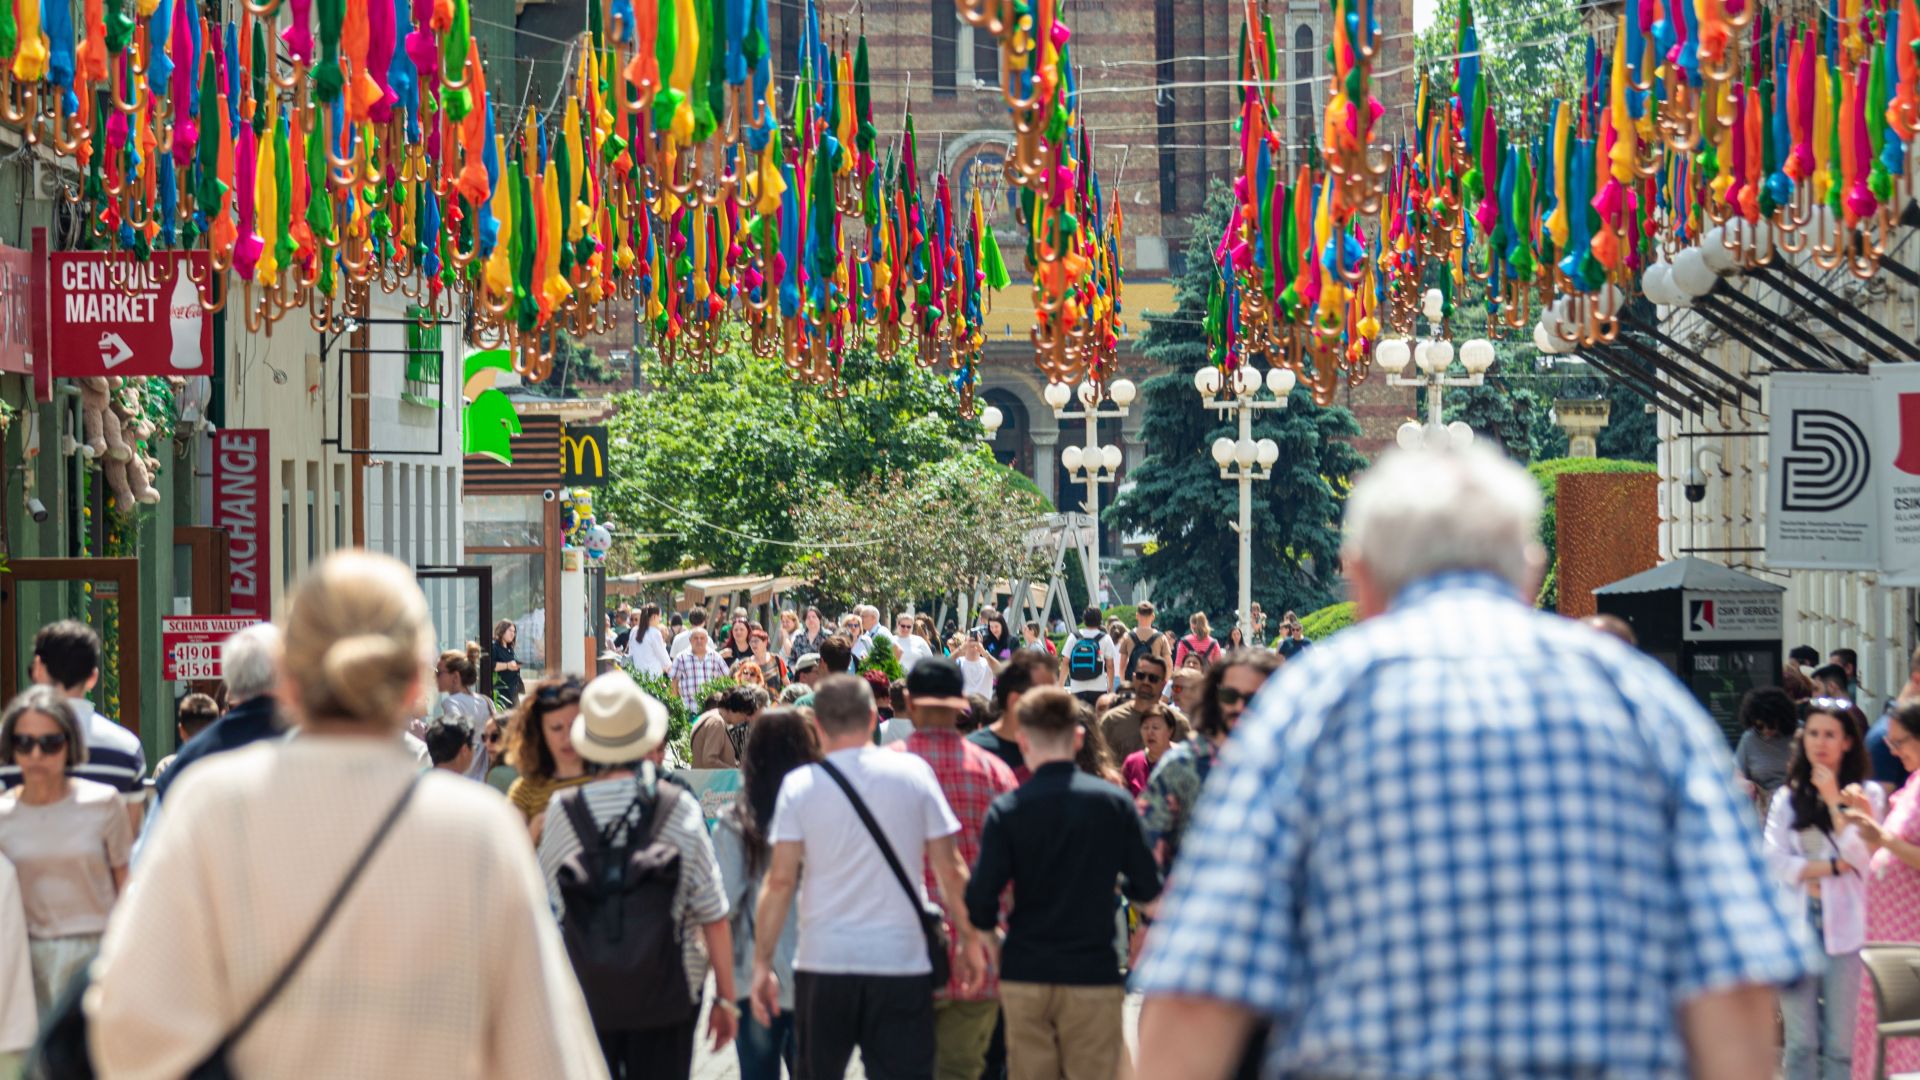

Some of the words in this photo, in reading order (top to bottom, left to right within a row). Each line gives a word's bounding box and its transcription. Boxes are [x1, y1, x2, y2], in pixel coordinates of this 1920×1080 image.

[62, 261, 161, 290] CENTRAL
[65, 293, 158, 323] MARKET
[219, 434, 257, 596] EXCHANGE
[169, 621, 208, 631] SCHIMB
